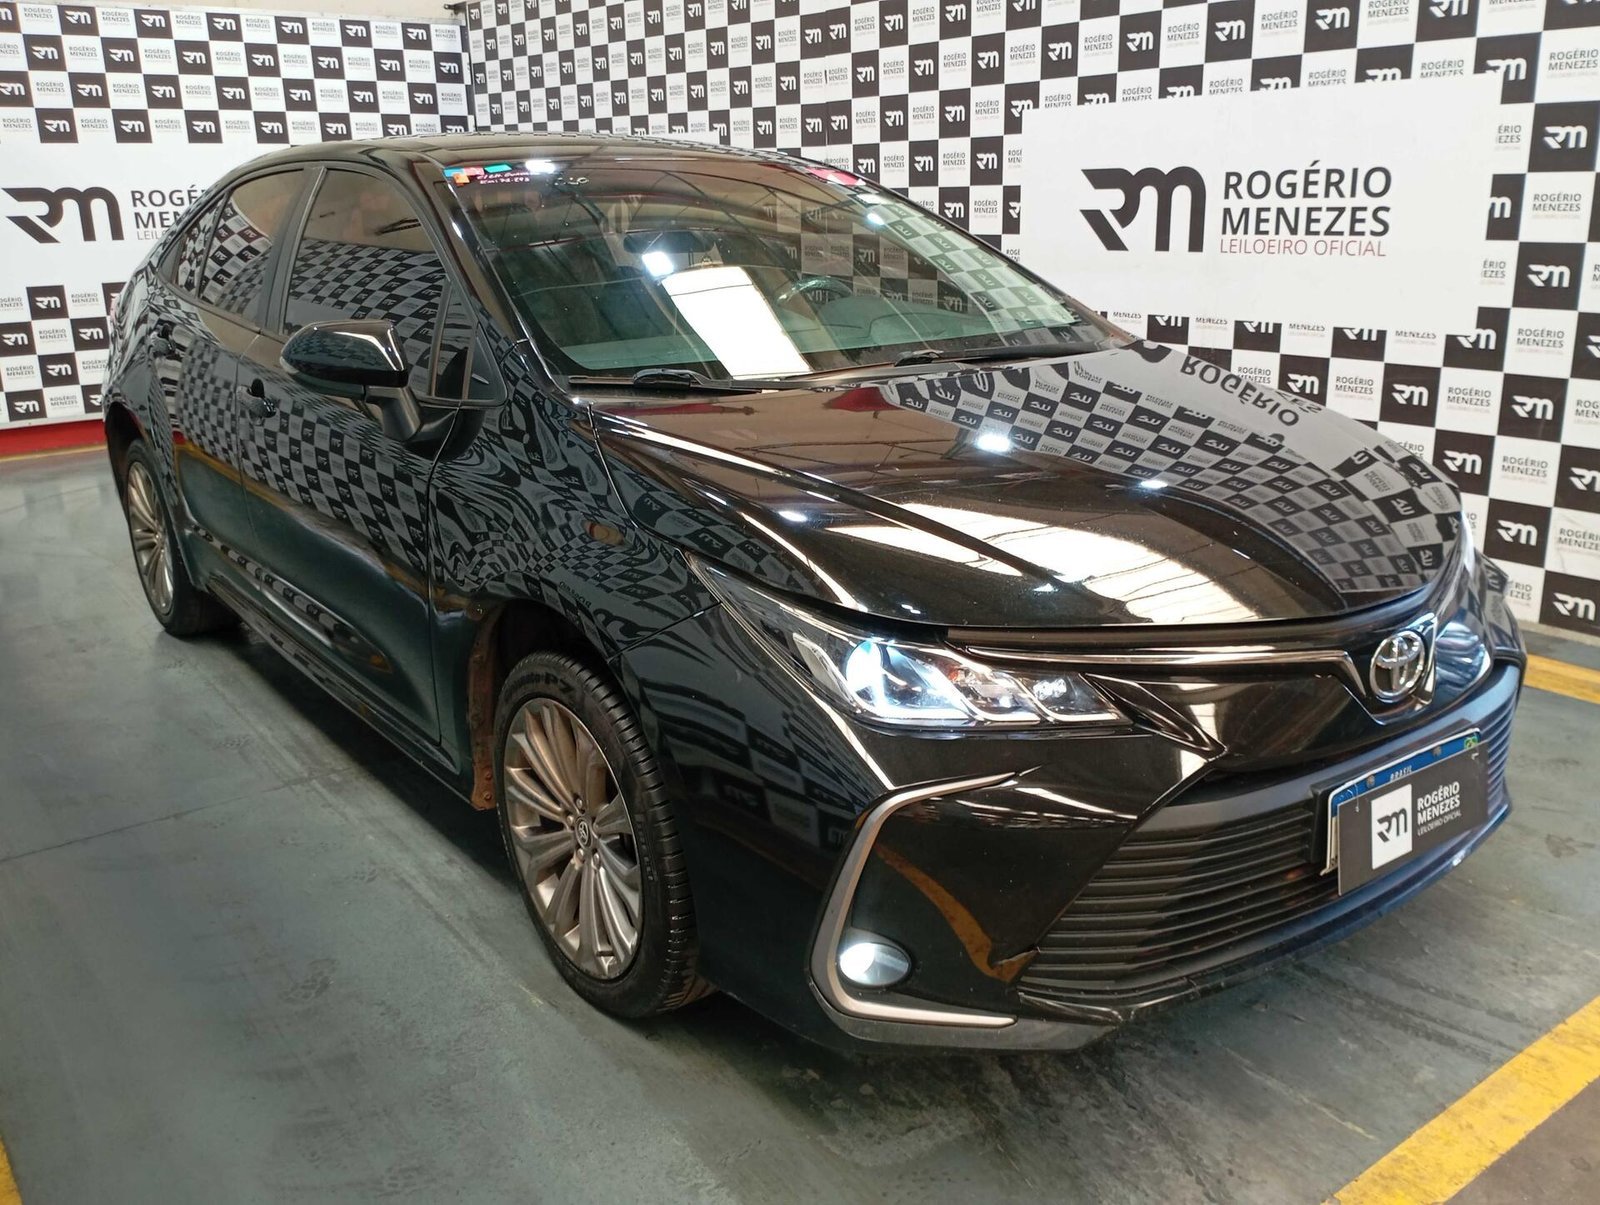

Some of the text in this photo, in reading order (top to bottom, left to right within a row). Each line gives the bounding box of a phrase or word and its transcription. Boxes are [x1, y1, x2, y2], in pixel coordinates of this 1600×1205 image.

[1261, 10, 1298, 21] ROGÉRIO
[1368, 7, 1409, 18] MENEZES
[913, 14, 934, 22] MENEZES
[1168, 23, 1199, 33] ROGÉRIO
[1261, 20, 1297, 30] MENEZES
[1084, 34, 1113, 43] ROGÉRIO
[1168, 32, 1199, 41] MENEZES
[1010, 44, 1035, 53] ROGÉRIO
[1084, 42, 1113, 51] MENEZES
[944, 53, 966, 61] ROGÉRIO
[1010, 52, 1036, 60] MENEZES
[1550, 50, 1599, 60] ROGÉRIO
[944, 60, 966, 68] MENEZES
[1421, 59, 1464, 70] ROGÉRIO
[1548, 60, 1598, 71] MENEZES
[1309, 70, 1346, 79] ROGÉRIO
[1209, 79, 1242, 87] ROGÉRIO
[1122, 87, 1152, 95] ROGÉRIO
[1045, 94, 1071, 102] ROGÉRIO
[976, 100, 999, 108] ROGÉRIO
[1224, 160, 1392, 200] ROGÉRIO
[131, 185, 206, 207] ROGÉ
[1534, 192, 1581, 202] ROGÉRIO
[1533, 203, 1580, 212] MENEZES
[1221, 206, 1391, 236] MENEZES
[1221, 238, 1386, 256] LEILOEIRO OFICIAL
[1518, 328, 1564, 338] ROGÉRIO
[1517, 337, 1564, 348] MENEZES
[1238, 366, 1271, 376] ROGÉRIO
[1336, 376, 1373, 386] ROGÉRIO
[1335, 385, 1373, 394] MENEZES
[1449, 387, 1491, 397] ROGÉRIO
[1447, 396, 1490, 407] MENEZES
[1502, 455, 1548, 468] ROGÉRIO
[1502, 465, 1547, 477] MENEZES
[1417, 782, 1460, 811] ROGÉRIO
[1418, 795, 1460, 825] MENEZES
